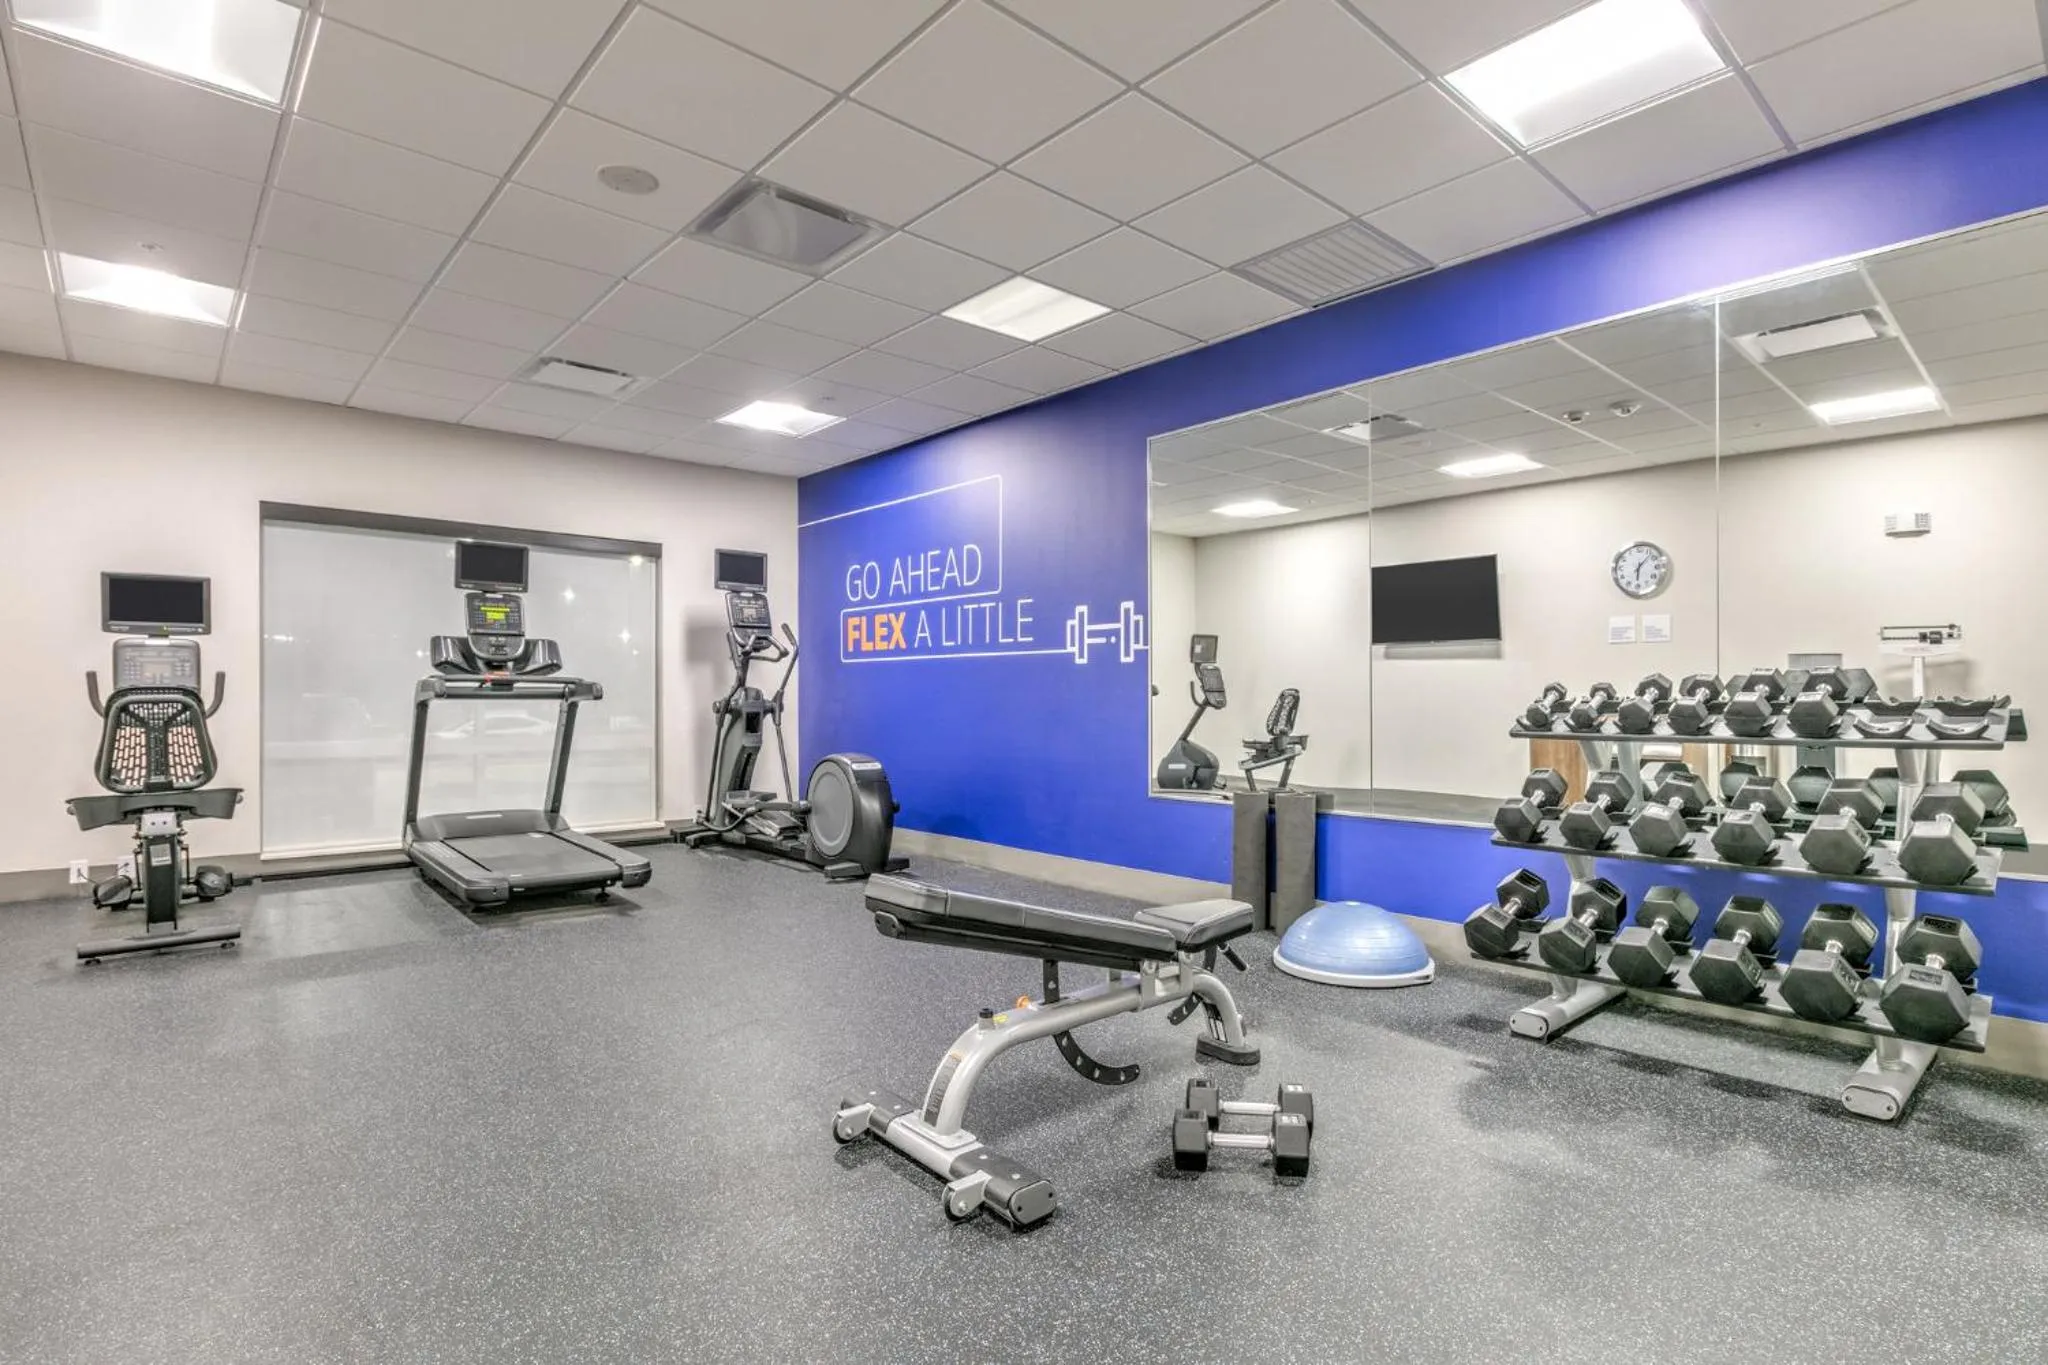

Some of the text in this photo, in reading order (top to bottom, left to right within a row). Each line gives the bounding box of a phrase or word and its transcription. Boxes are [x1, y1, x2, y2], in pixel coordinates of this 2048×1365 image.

[846, 543, 982, 602] GO AHEAD
[847, 598, 1035, 653] FLEX A LITTLE
